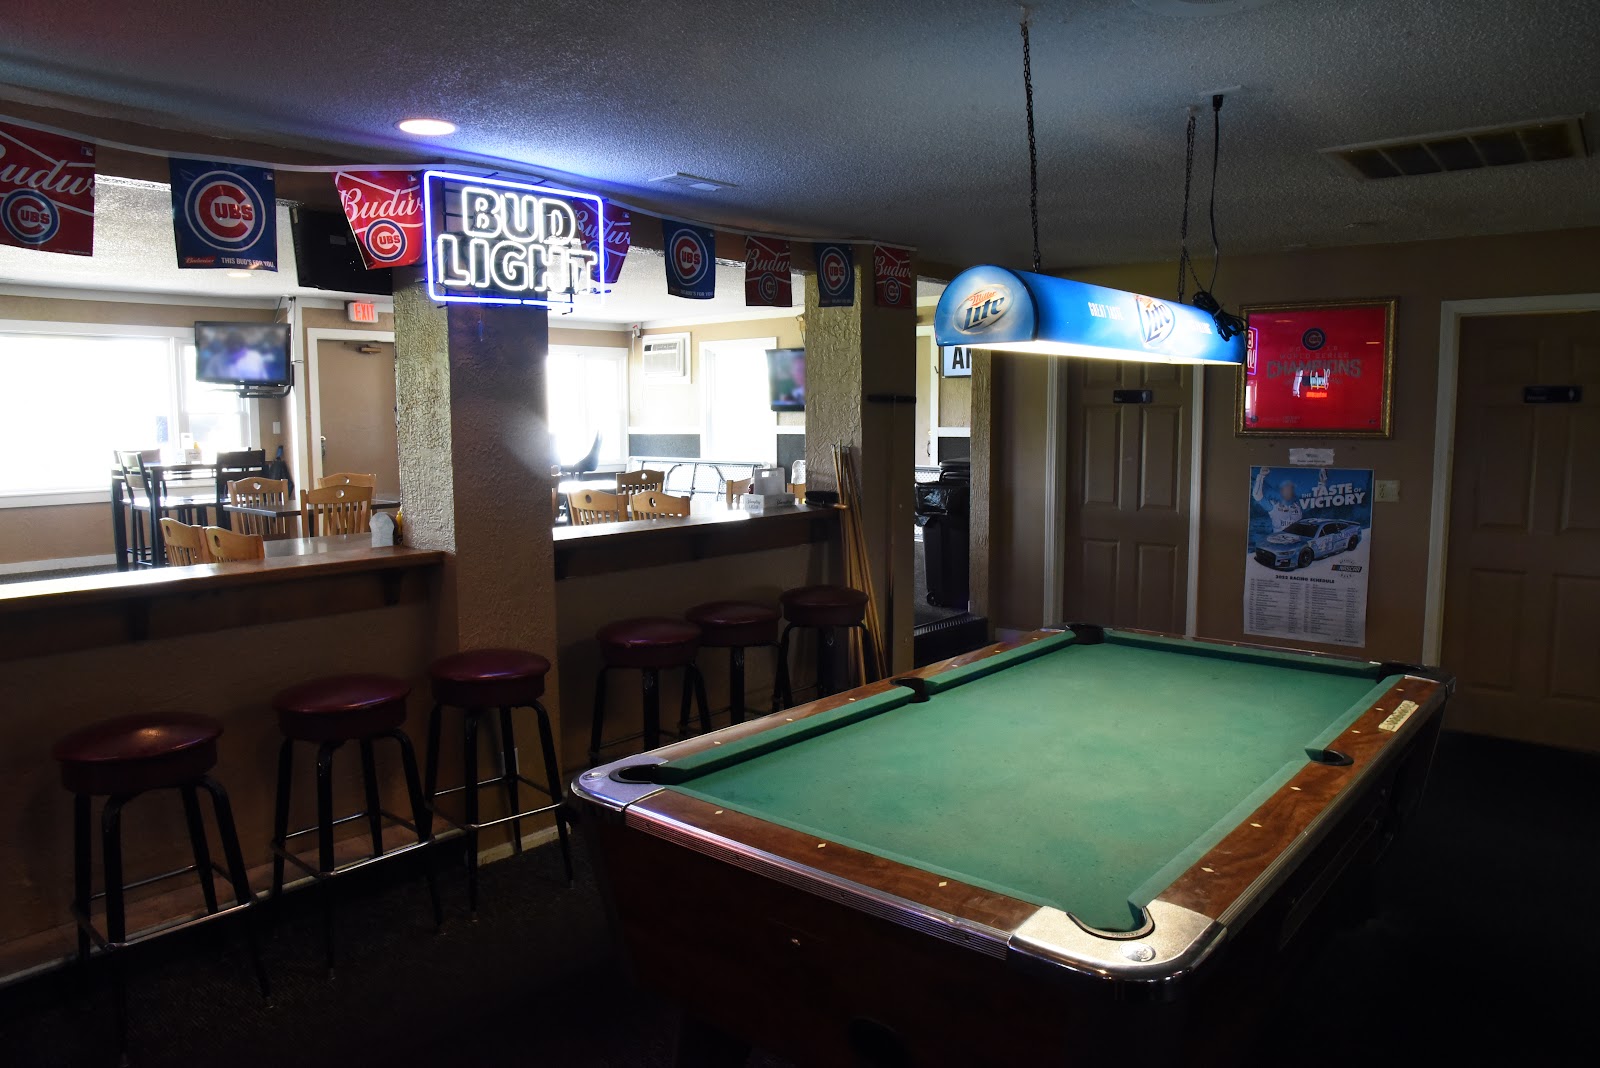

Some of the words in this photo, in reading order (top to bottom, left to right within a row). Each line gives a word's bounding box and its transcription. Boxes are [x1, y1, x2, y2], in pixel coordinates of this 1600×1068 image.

[0, 144, 95, 197] udw
[338, 188, 424, 222] Budw
[461, 187, 576, 246] BUD
[574, 210, 630, 245] Budw
[437, 234, 598, 294] LIGHT
[745, 248, 792, 272] Budw
[874, 255, 911, 278] Budw
[968, 291, 997, 305] Miller
[353, 302, 375, 321] EXIT
[962, 296, 1005, 331] Lite
[1088, 302, 1107, 319] GREAT
[1266, 358, 1361, 378] CHAMPIONS
[1299, 492, 1366, 510] VICTORY
[1312, 482, 1353, 497] TASTE
